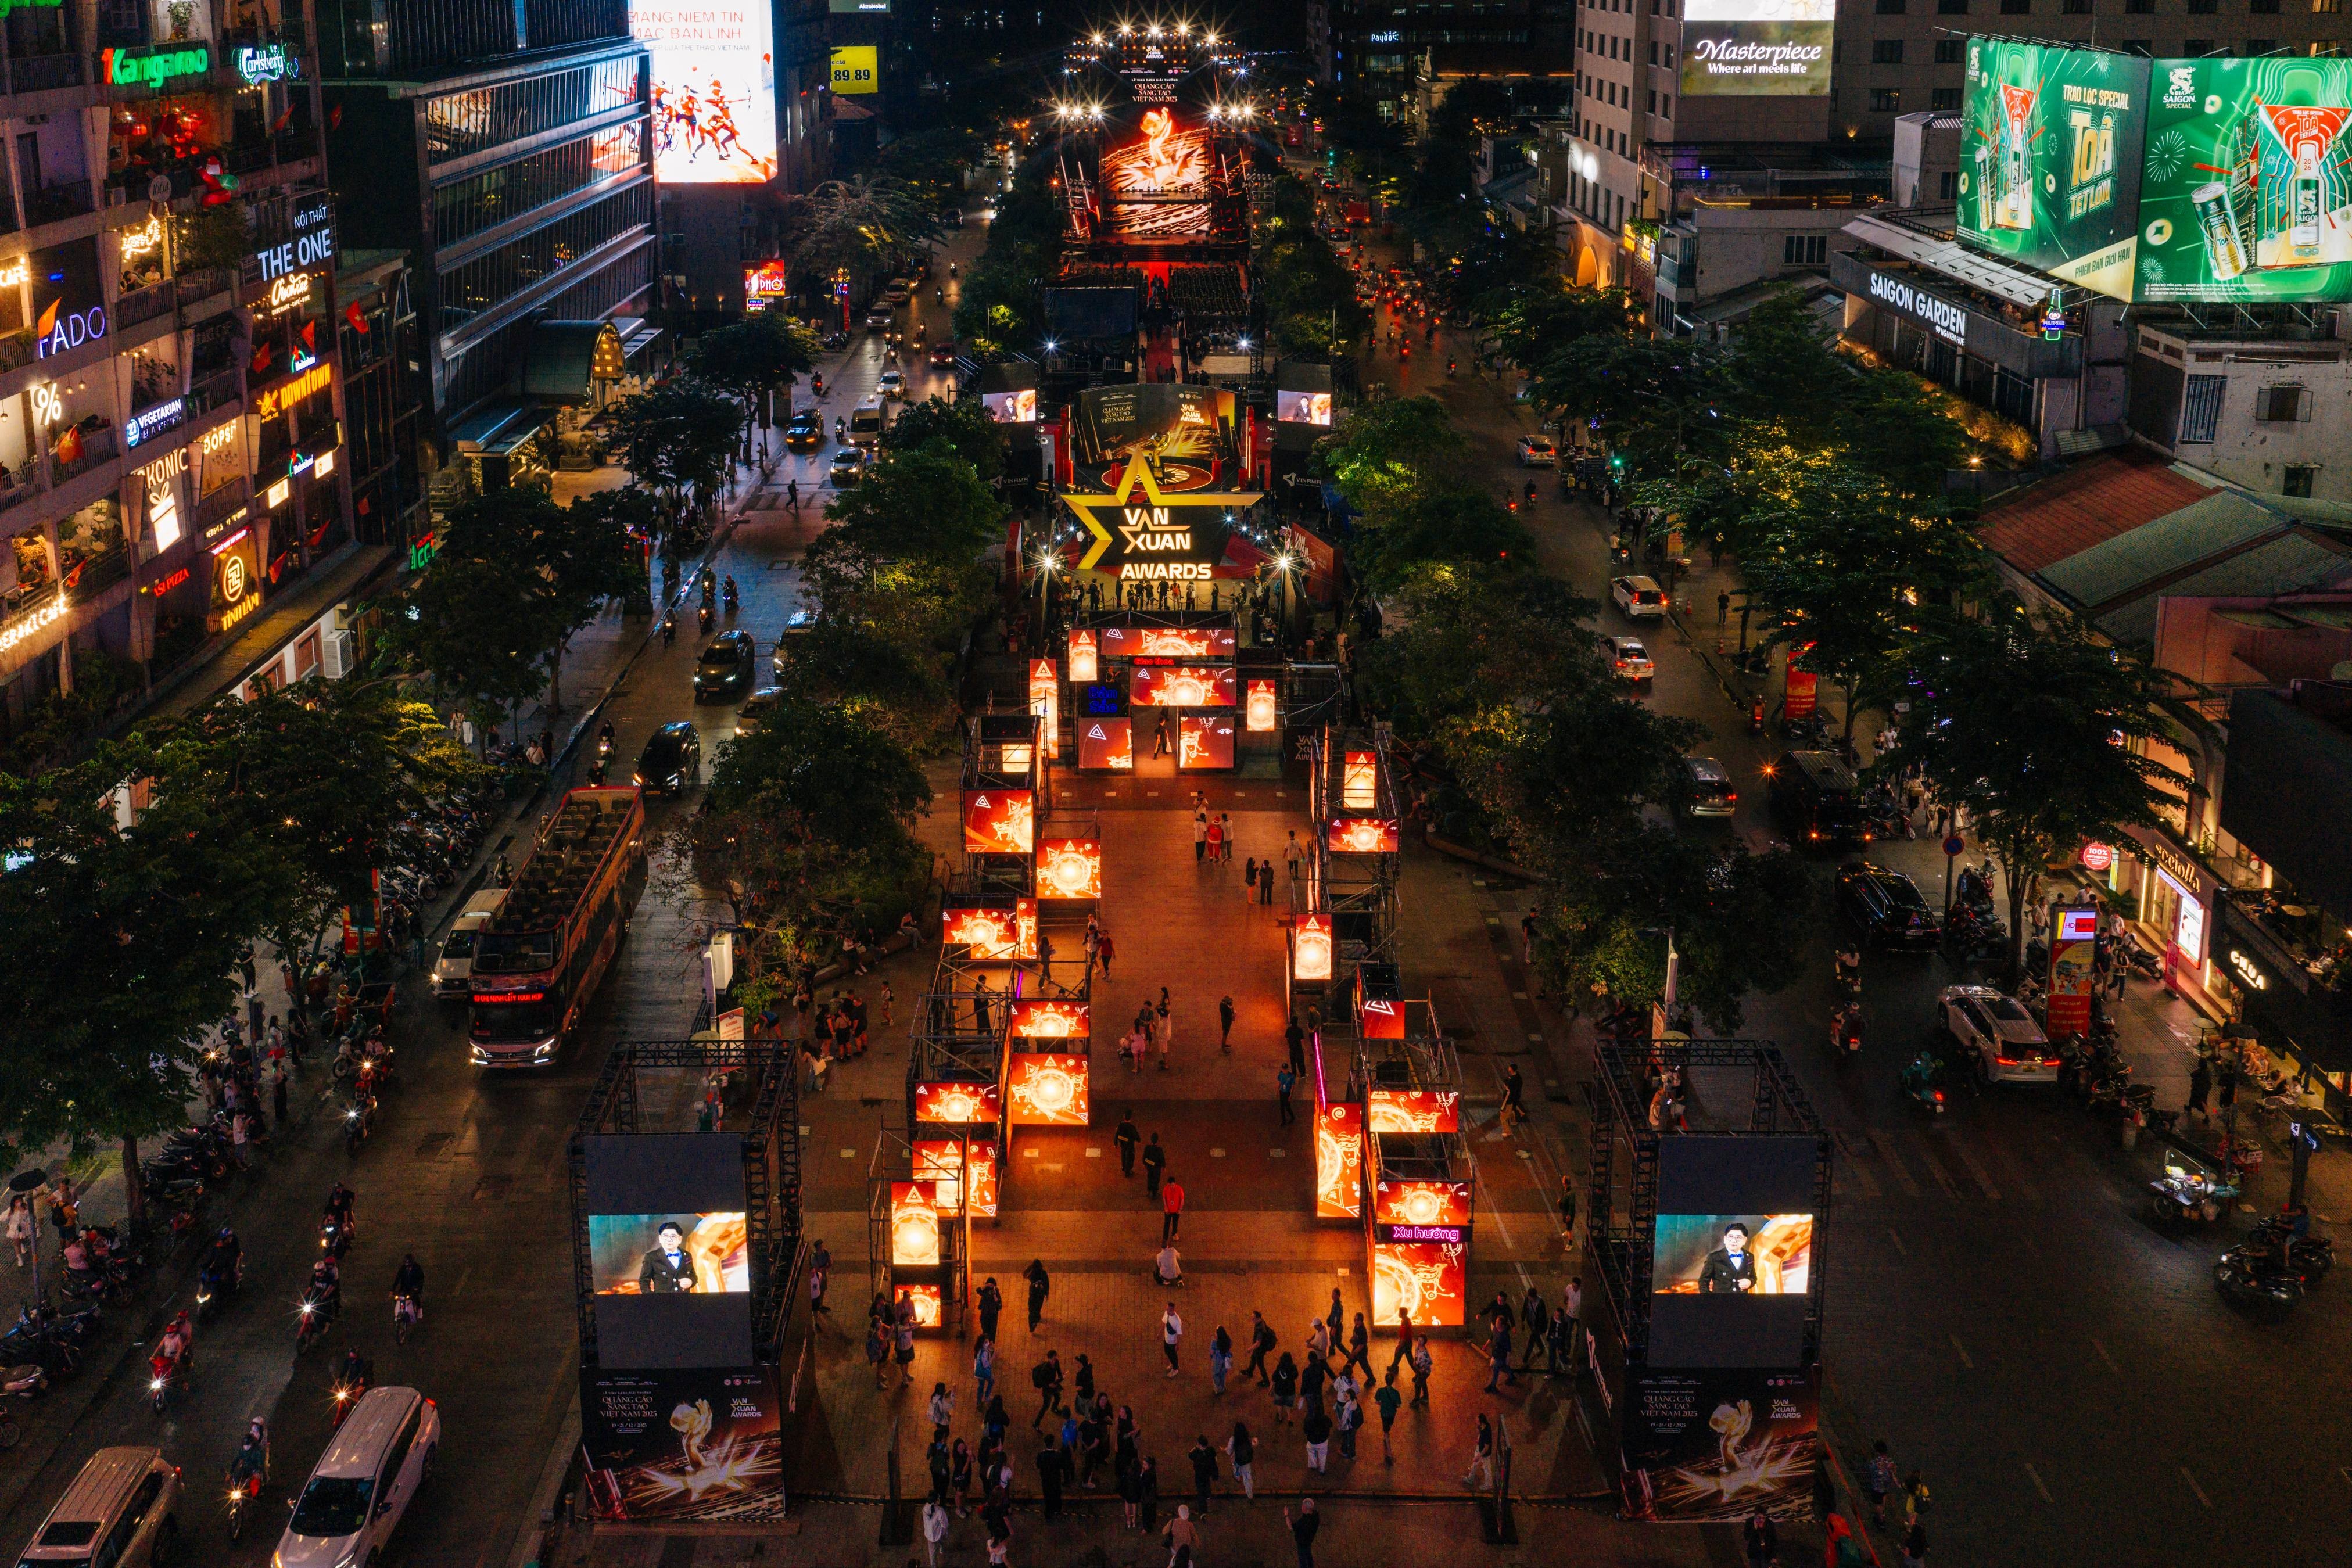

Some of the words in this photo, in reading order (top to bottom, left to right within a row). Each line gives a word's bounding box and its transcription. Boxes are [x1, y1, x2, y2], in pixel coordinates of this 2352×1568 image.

[721, 12, 743, 23] TIN
[242, 46, 284, 79] Carlsberg
[1695, 39, 1822, 66] Masterpiece
[1708, 63, 1741, 74] Where
[1743, 63, 1757, 74] art
[1759, 63, 1789, 74] meets
[1791, 63, 1807, 74] life
[2063, 85, 2081, 102] TRAO
[2083, 87, 2097, 106] LỘC
[2099, 89, 2129, 110] SPECIAL
[295, 210, 307, 229] NỘI
[309, 203, 327, 224] THẤT
[257, 242, 294, 282] THE
[298, 228, 332, 266] ONE
[2118, 247, 2131, 263] HẠN
[1870, 272, 1913, 312] SAIGON
[1916, 293, 1966, 336] GARDEN
[1935, 325, 1941, 333] 99
[138, 399, 181, 429] VEGETARIAN
[1124, 507, 1168, 526] VAN
[166, 568, 189, 590] PIZZA
[1121, 563, 1212, 580] AWARDS
[2089, 848, 2108, 856] 100%
[1393, 1226, 1412, 1238] Xu
[1414, 1226, 1459, 1242] hướng
